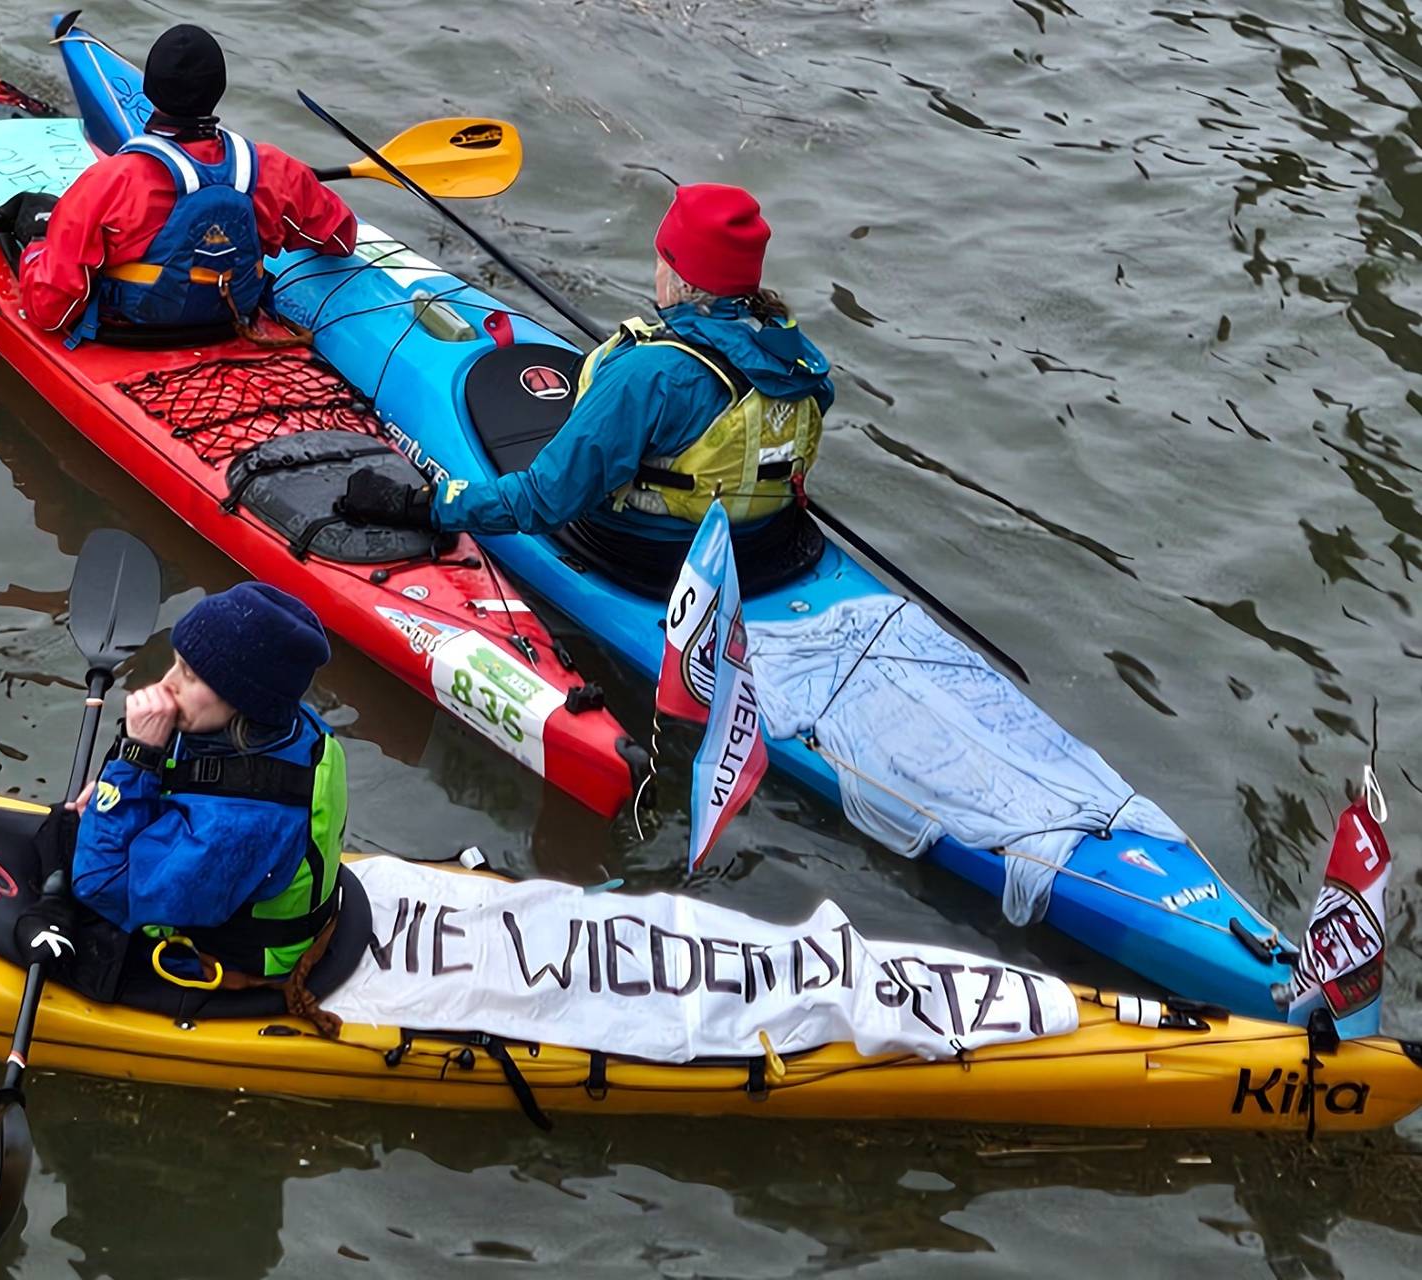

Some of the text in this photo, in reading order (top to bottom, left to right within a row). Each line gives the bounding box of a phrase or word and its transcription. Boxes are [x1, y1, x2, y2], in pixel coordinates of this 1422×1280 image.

[450, 668, 525, 743] 835
[502, 911, 778, 1004] WIEDER
[790, 922, 853, 995] IST
[874, 956, 1046, 1037] JETZT
[1231, 1067, 1371, 1115] Kira
